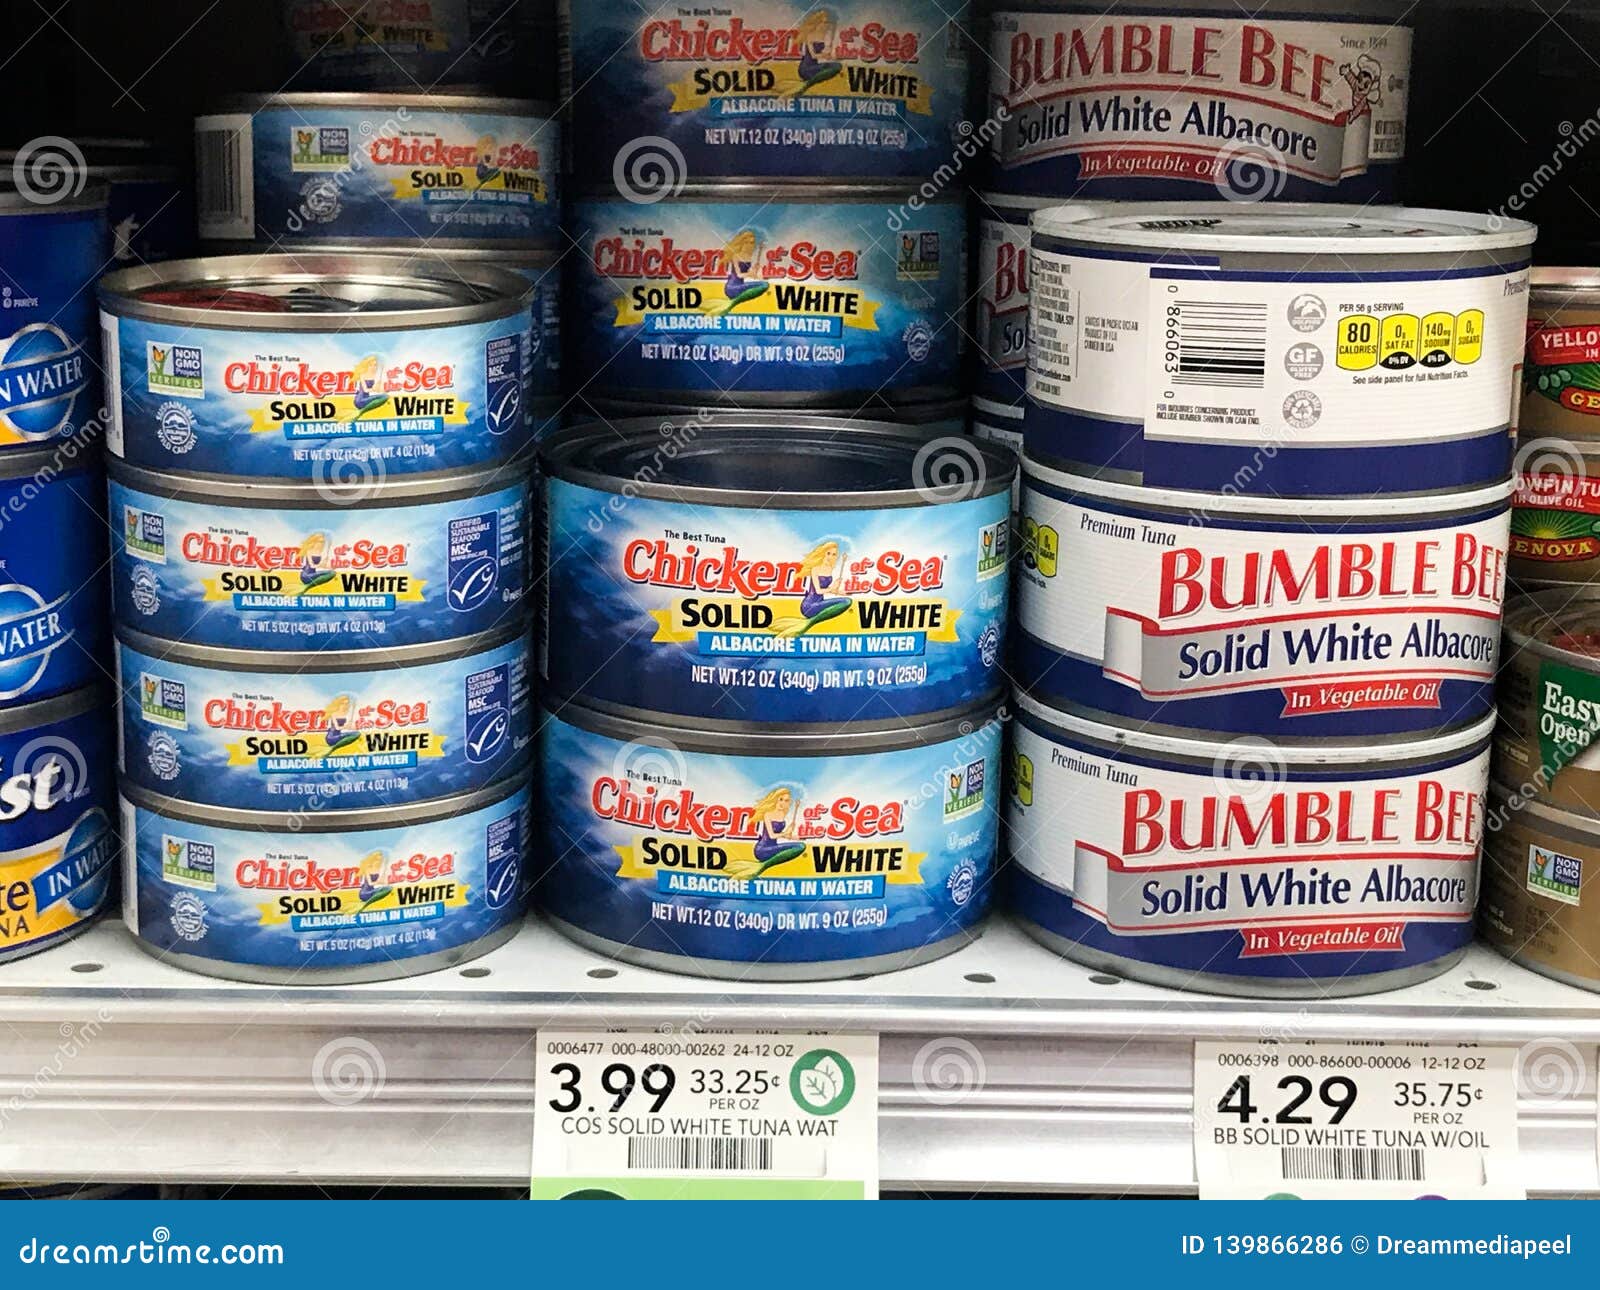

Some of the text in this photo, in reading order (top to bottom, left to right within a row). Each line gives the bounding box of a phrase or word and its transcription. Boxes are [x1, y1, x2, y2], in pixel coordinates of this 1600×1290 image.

[640, 18, 920, 64] Chicken Sea
[1008, 24, 1337, 110] BUMBLE BEE
[694, 67, 919, 98] SOLID WHITE
[1017, 101, 1071, 149] Solid
[1079, 96, 1171, 134] White
[1180, 101, 1317, 162] Albacore
[1086, 155, 1222, 176] In Vegetable Oil
[411, 170, 542, 193] SOLID WHITE
[594, 237, 858, 283] Chicken Sea
[632, 286, 858, 314] SOLID WHITE
[1374, 303, 1404, 311] SERVING
[1165, 306, 1180, 373] 866063
[1347, 323, 1370, 342] 80
[1424, 339, 1450, 348] SODIUM
[1458, 335, 1480, 344] SUGARS
[1541, 331, 1600, 348] YELLO
[1289, 348, 1318, 363] GF
[1339, 345, 1376, 354] CALORIES
[1386, 340, 1414, 349] SAT FAT
[17, 355, 82, 398] WATER
[224, 361, 453, 398] Chicken Sea
[1353, 376, 1366, 384] See
[1369, 374, 1382, 384] side
[1384, 374, 1403, 384] panel
[1405, 373, 1414, 382] for
[1416, 373, 1425, 382] full
[270, 399, 454, 421] SOLID WHITE
[293, 420, 435, 435] ALBACORE TUNA IN WATER
[1514, 478, 1573, 494] OWFIN
[1530, 496, 1584, 508] OLIVE OIL
[664, 530, 725, 544] The Best Tuna
[1081, 513, 1177, 546] Premium Tuna
[181, 532, 408, 570] Chicken Sea
[1515, 540, 1592, 556] ENOVA
[623, 538, 944, 598] Chicken of the Sea
[1159, 532, 1502, 620] BUMBLE BEE
[222, 572, 408, 592] SOLID WHITE
[681, 598, 942, 629] SOLID WHITE
[710, 635, 915, 653] ALBACORE TUNA IN WATER
[1178, 620, 1493, 680] Solid White Albacore
[692, 665, 713, 684] NET
[760, 670, 775, 688] OZ
[779, 670, 819, 691] (340g)
[823, 670, 840, 688] DR
[844, 670, 863, 688] WT.
[867, 668, 874, 686] 9
[878, 667, 892, 685] OZ
[895, 663, 926, 685] (255g)
[1291, 683, 1437, 709] In Vegetable Oil
[1543, 681, 1600, 731] Easy
[204, 699, 428, 734] Chicken Sea
[1541, 712, 1590, 748] Open
[246, 733, 429, 755] SOLID WHITE
[1051, 748, 1138, 787] Premium Tuna
[592, 776, 902, 843] Chicken Sea
[1123, 780, 1479, 857] BUMBLE BEE
[642, 837, 901, 871] SOLID WHITE
[1557, 858, 1579, 870] NON
[235, 854, 454, 892] Chicken Sea
[1556, 866, 1578, 878] GMO
[669, 876, 872, 896] ALBACORE TUNA IN WATER
[1141, 864, 1465, 916] Solid White Albacore
[1531, 877, 1577, 895] VERIFIED
[279, 884, 454, 914] SOLID WHITE
[1250, 926, 1399, 949] In Vegetable Oil
[548, 1043, 793, 1057] 0006477 000-48000-00262 24-12 OZ
[1218, 1054, 1485, 1069] 0006398 000-86600-00006 12-12 OZ
[549, 1062, 676, 1113] 3.99
[709, 1098, 759, 1110] PER OZ
[1217, 1075, 1357, 1124] 4.29
[562, 1117, 838, 1136] COS SOLID WHITE TUNA WAT
[1414, 1113, 1462, 1124] PER OZ
[1214, 1128, 1489, 1148] BB SOLID WHITE TUNA W/OIL
